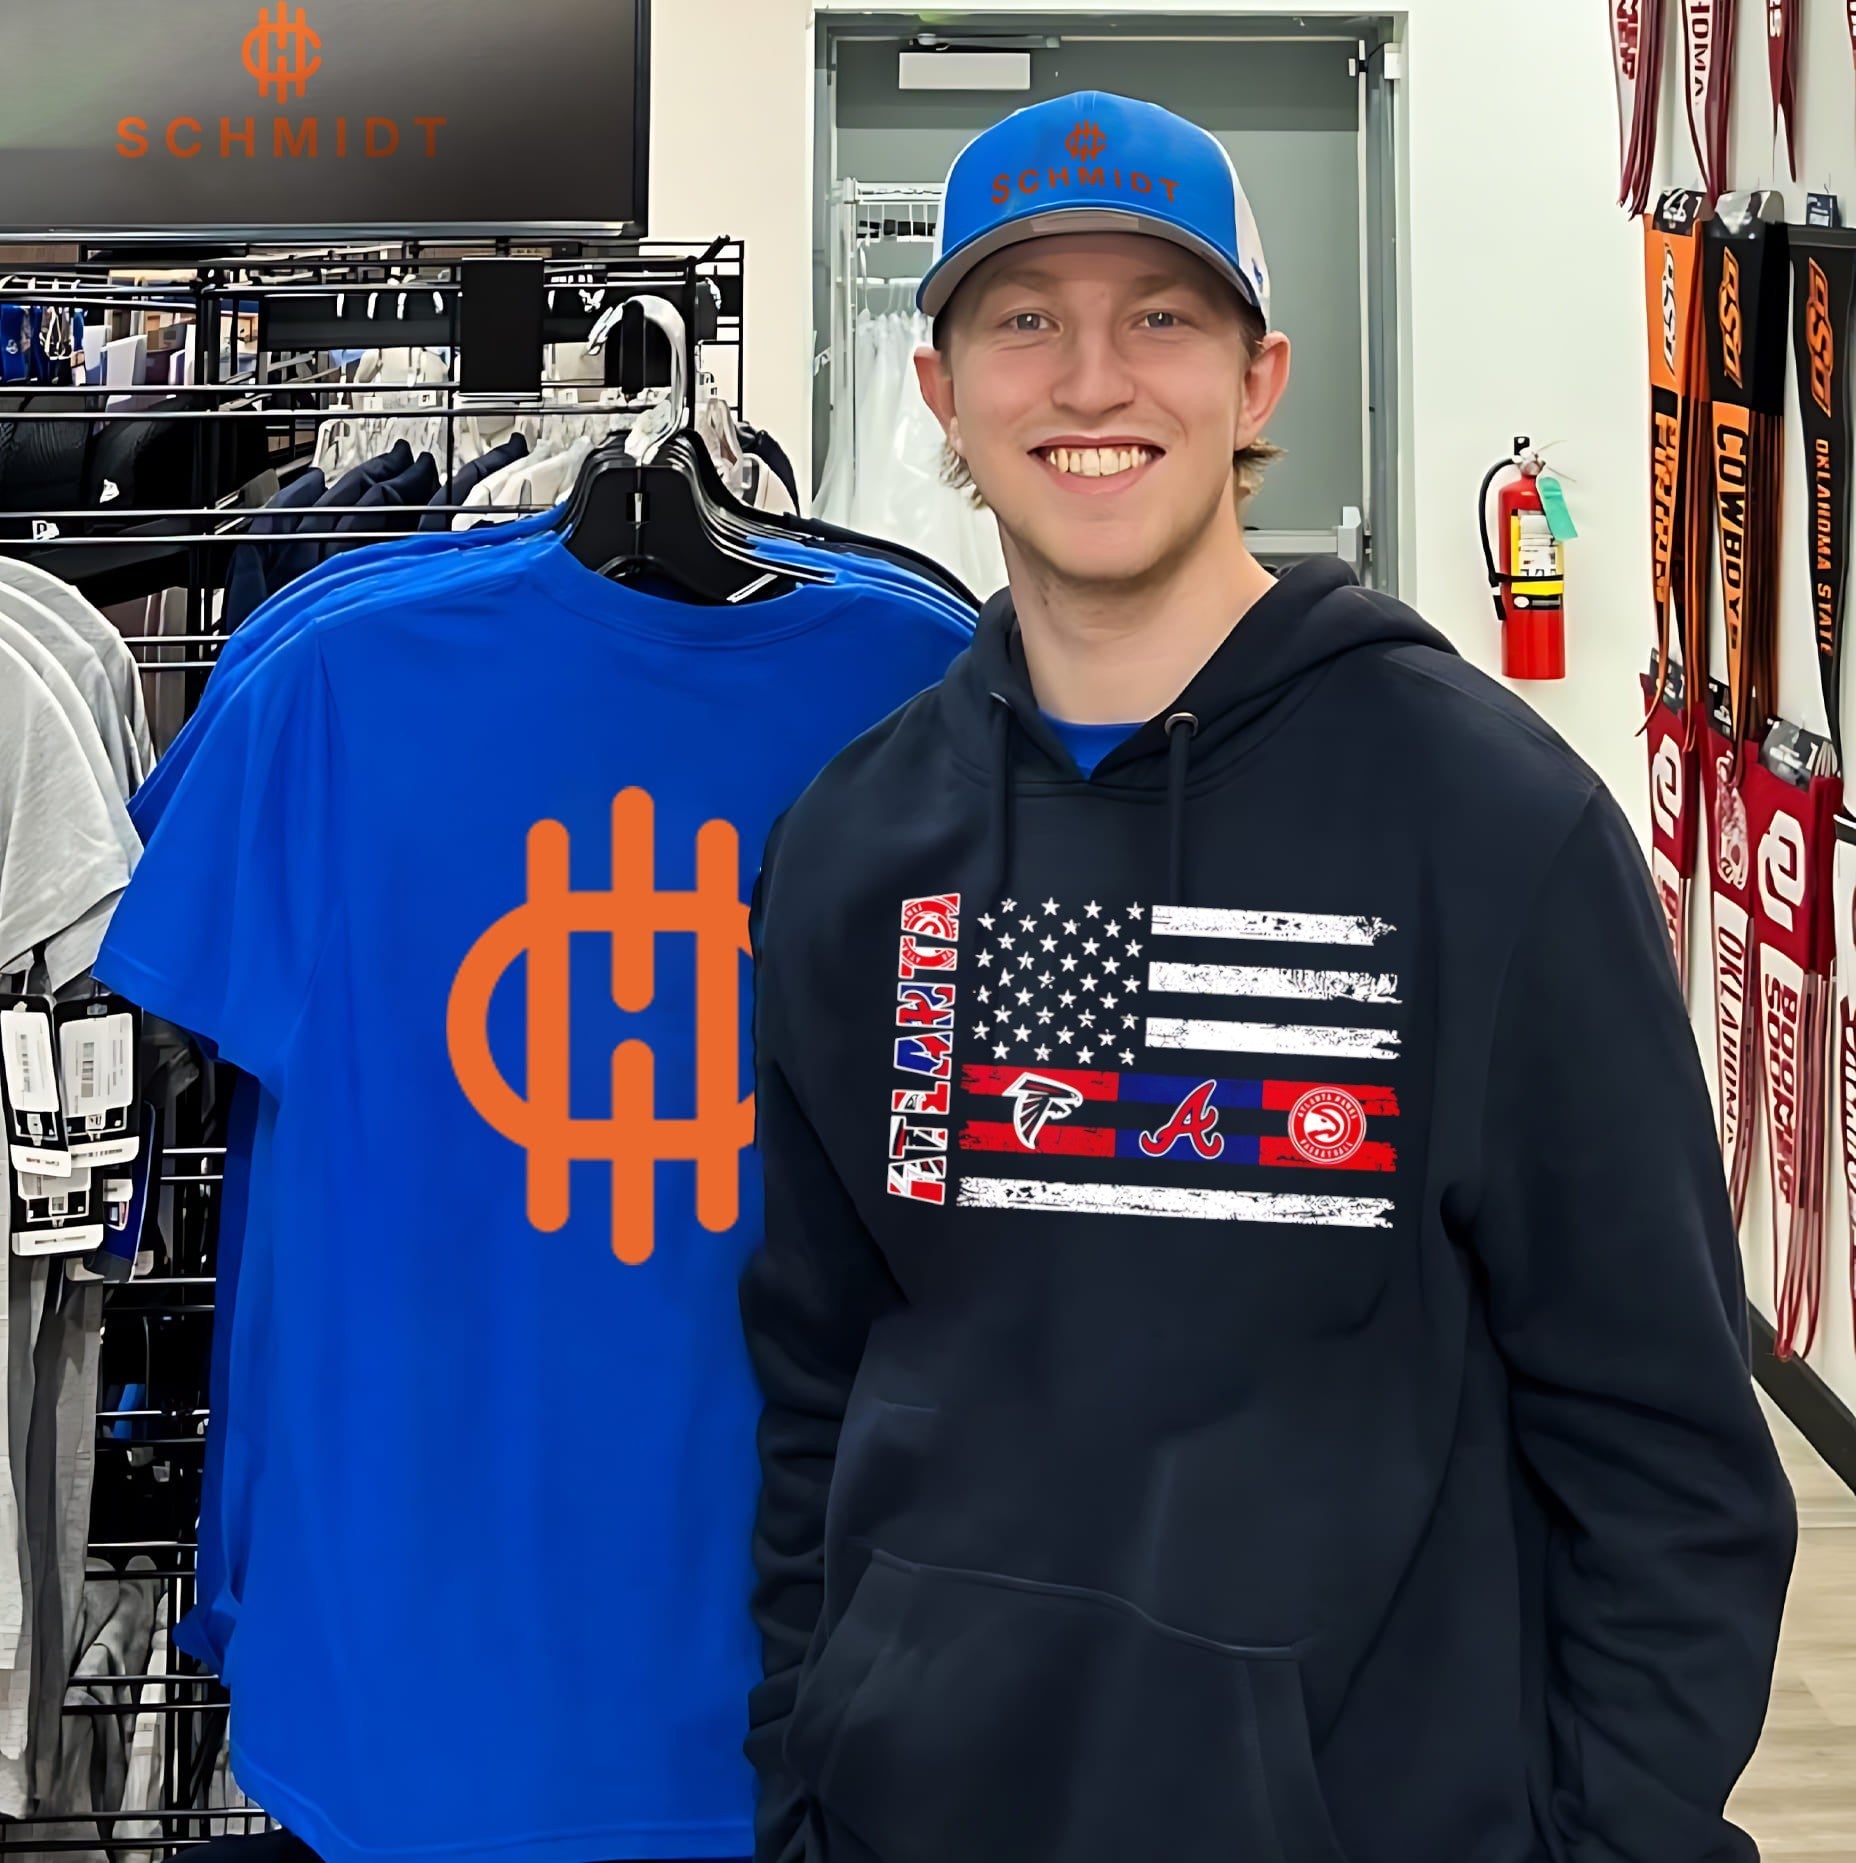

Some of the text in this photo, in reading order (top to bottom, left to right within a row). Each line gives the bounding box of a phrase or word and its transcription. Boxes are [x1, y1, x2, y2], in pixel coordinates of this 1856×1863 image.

[116, 116, 448, 159] SCHMIDT
[991, 166, 1179, 205] SCHMIDT
[887, 893, 960, 1206] ATLANTA
